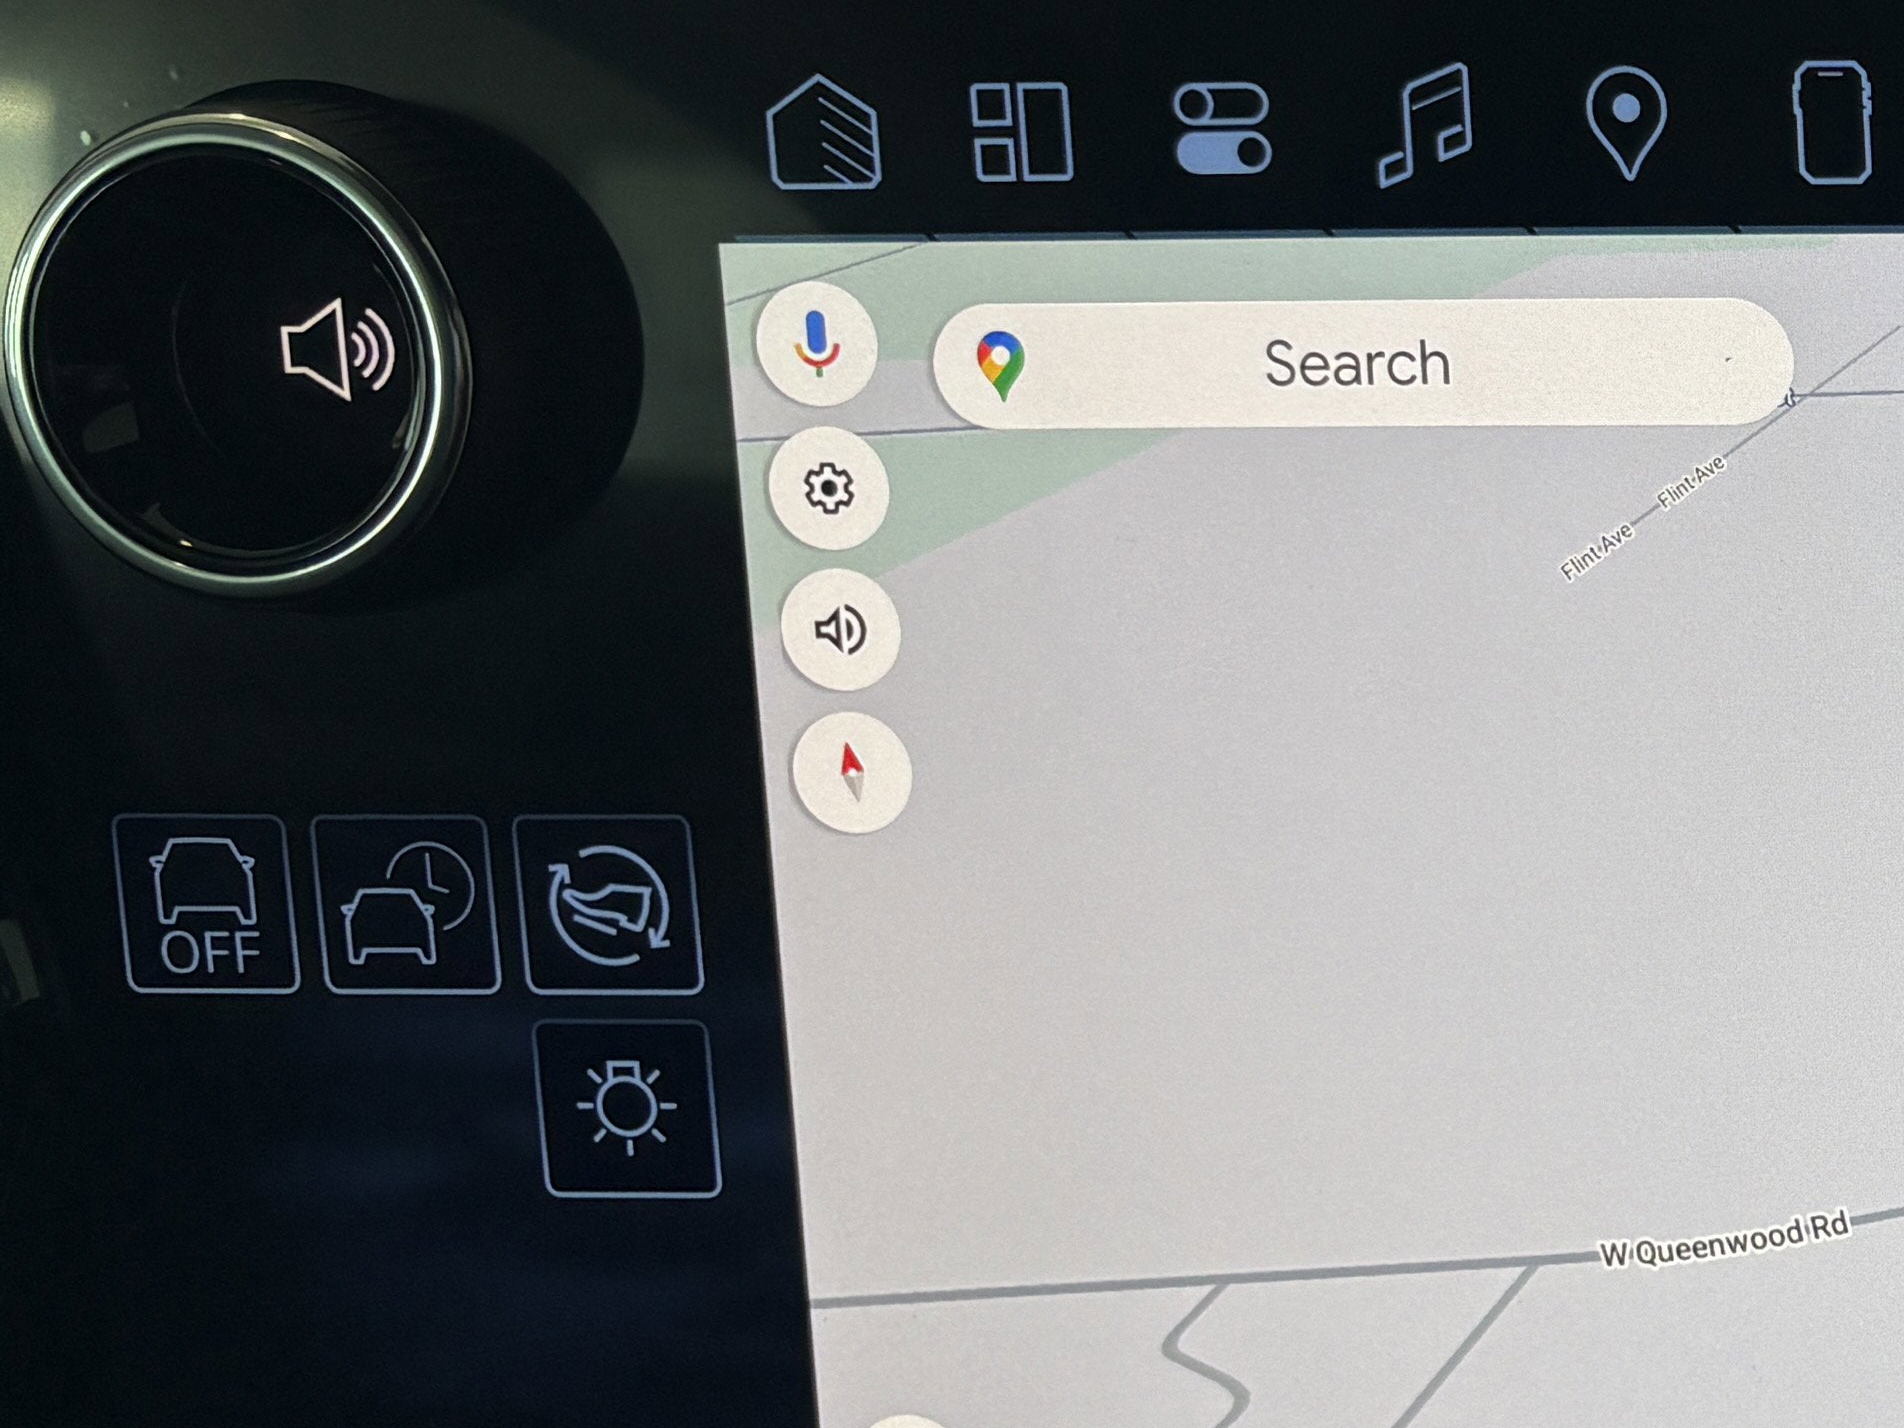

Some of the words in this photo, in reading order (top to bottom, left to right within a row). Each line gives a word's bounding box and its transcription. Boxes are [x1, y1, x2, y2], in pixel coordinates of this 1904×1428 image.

[1265, 339, 1450, 389] Search
[1658, 477, 1695, 508] Flint
[1695, 457, 1725, 483] Ave
[1561, 547, 1601, 580] Flint
[1602, 524, 1632, 553] Ave
[161, 930, 259, 973] OFF
[1601, 1243, 1629, 1266] W
[1636, 1220, 1804, 1266] Queenwood
[1810, 1211, 1848, 1238] Rd
